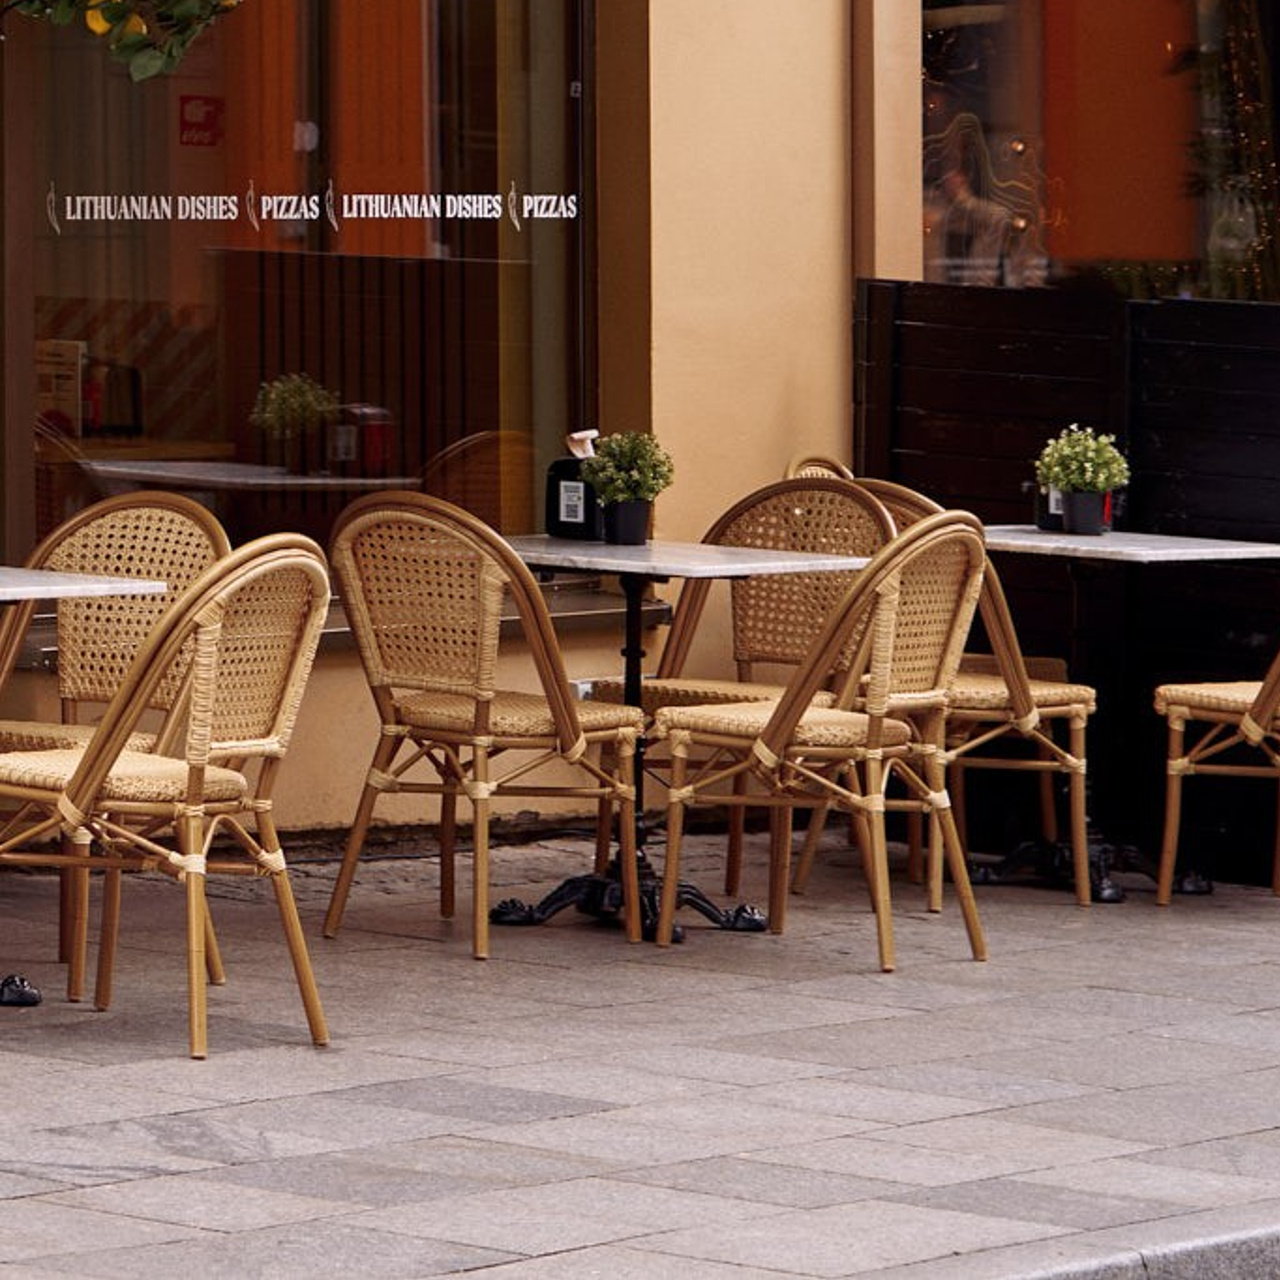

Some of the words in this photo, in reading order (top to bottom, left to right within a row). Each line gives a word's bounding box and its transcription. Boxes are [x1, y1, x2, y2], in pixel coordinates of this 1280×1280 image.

[65, 195, 171, 220] LITHUANIAN
[177, 195, 239, 220] DISHES
[261, 195, 320, 220] PIZZAS
[342, 194, 441, 219] LITHUANIAN
[445, 194, 503, 219] DISHES
[522, 194, 578, 219] PIZZAS
